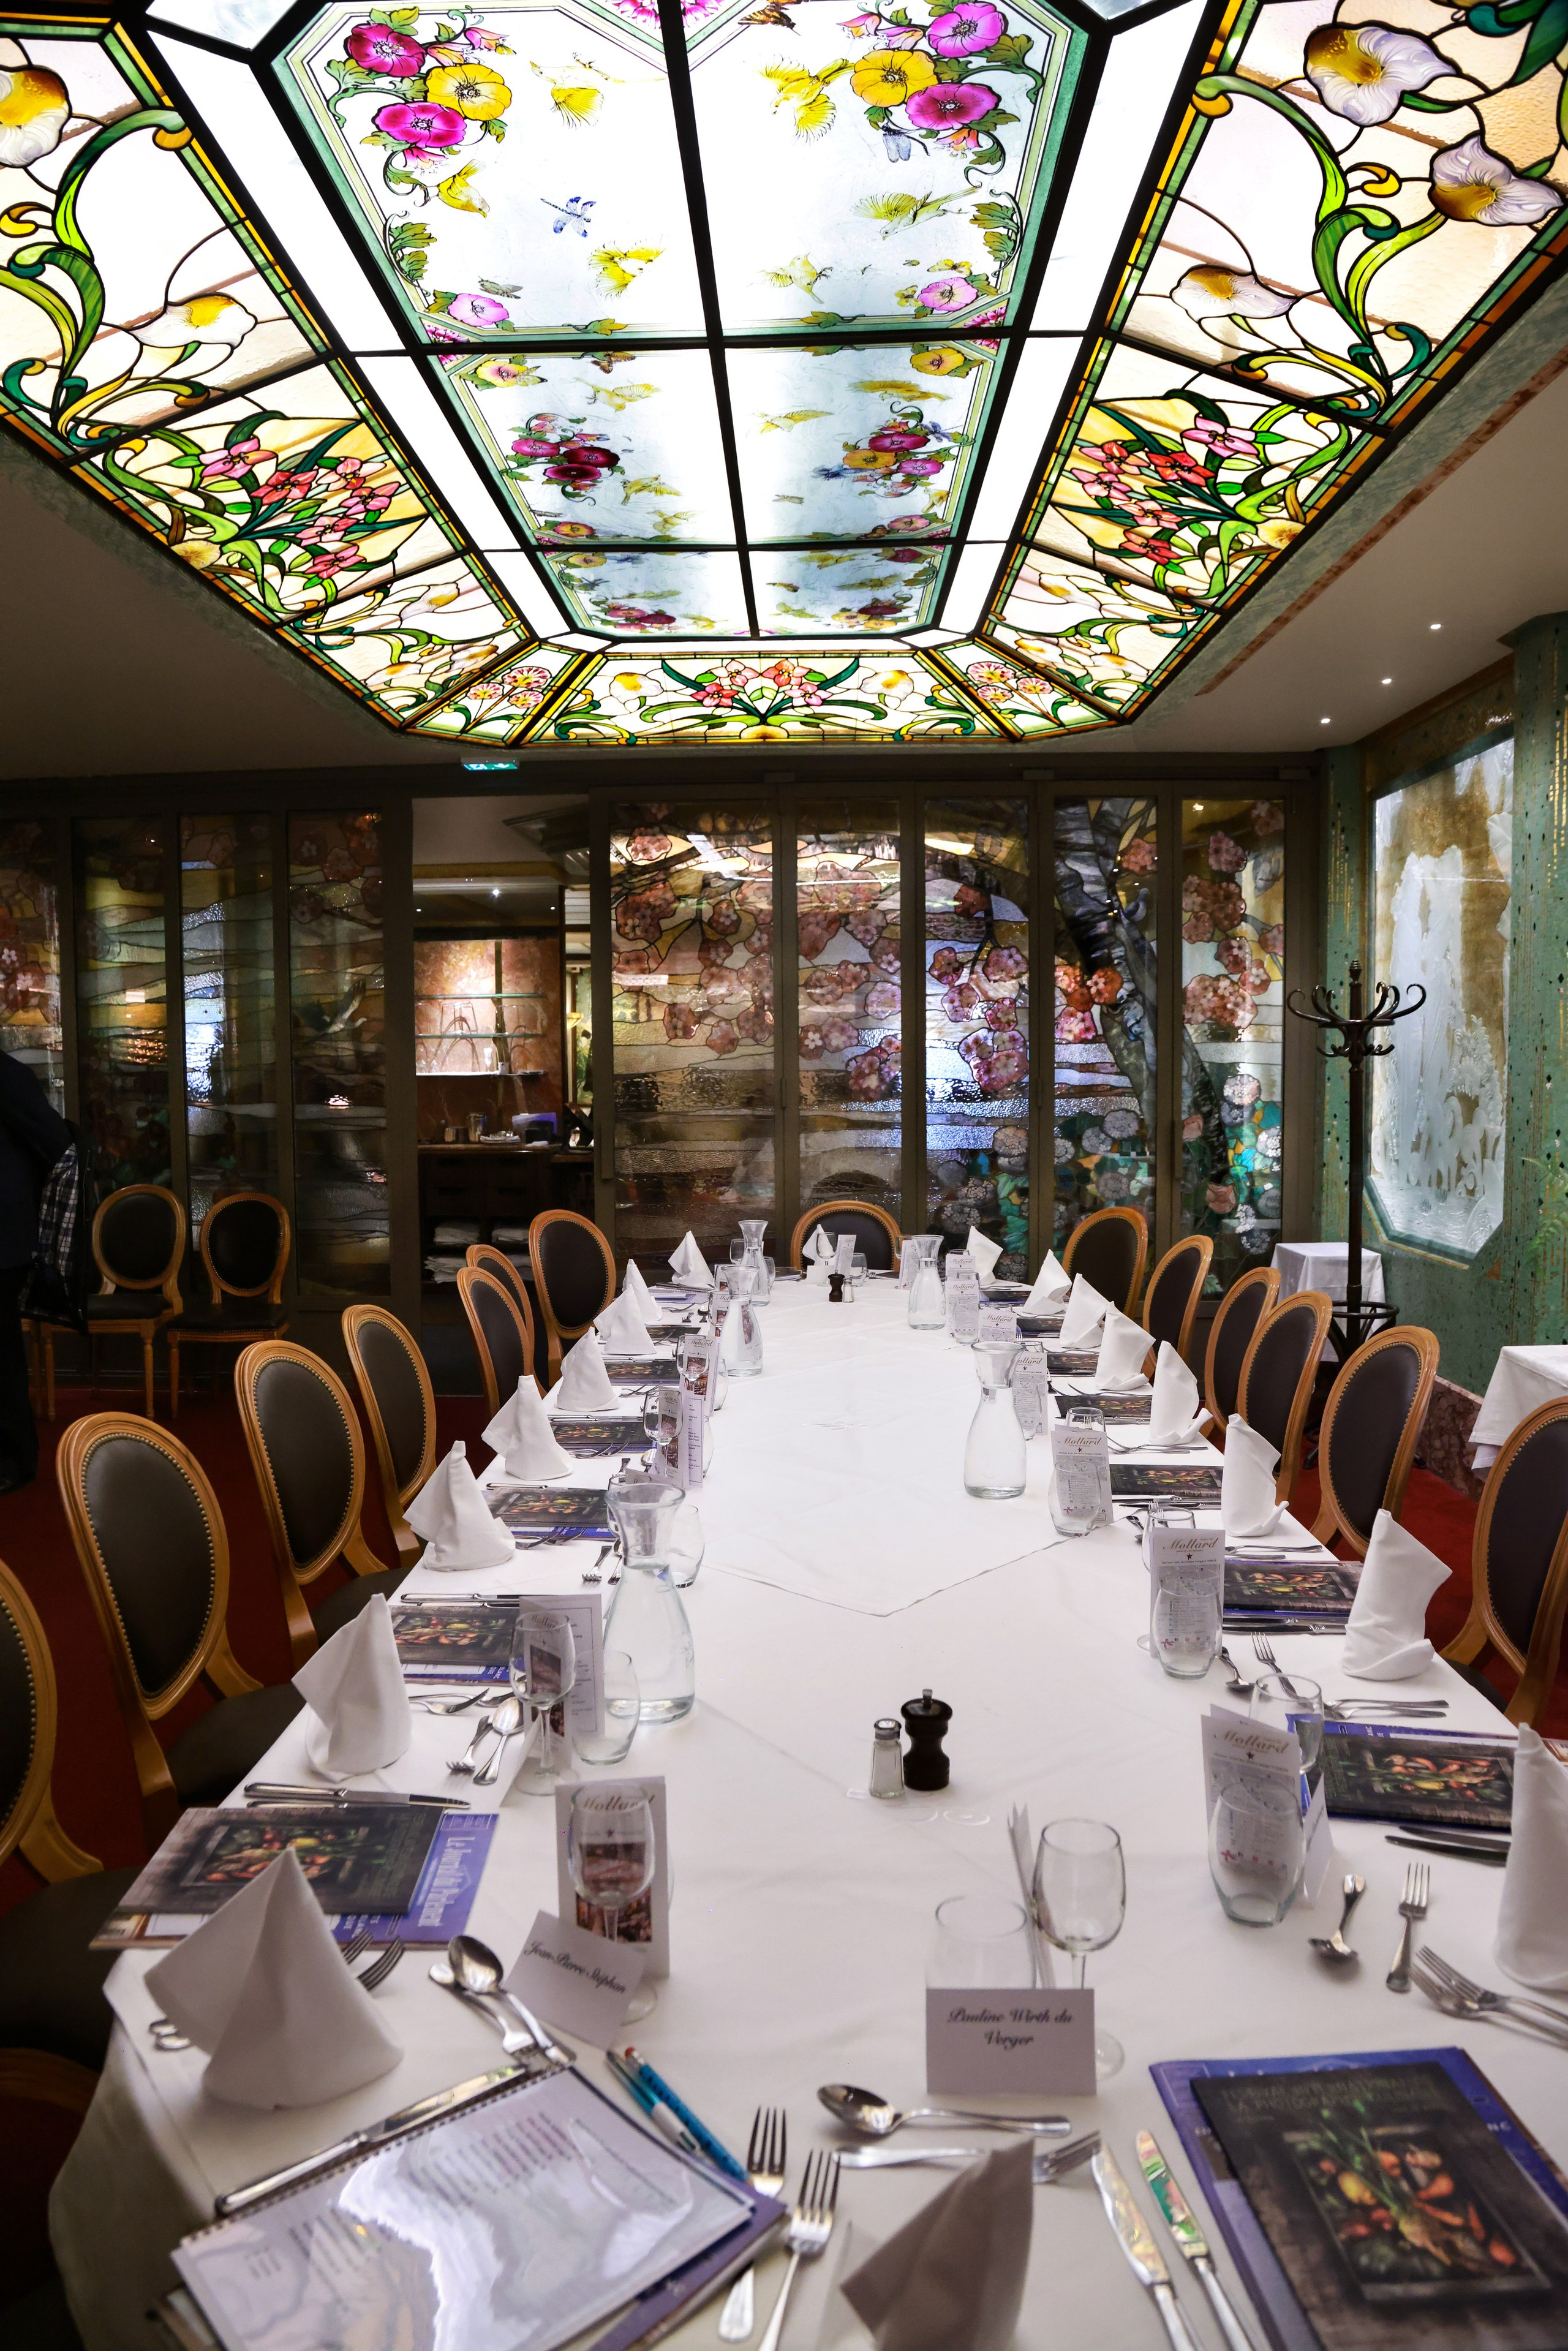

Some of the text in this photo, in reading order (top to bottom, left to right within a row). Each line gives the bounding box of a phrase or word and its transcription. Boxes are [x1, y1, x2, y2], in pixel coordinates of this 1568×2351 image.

[1058, 1436, 1102, 1446] Mollard
[1163, 1538, 1218, 1550] Mollard
[1214, 1730, 1289, 1754] Mollard
[948, 2007, 1005, 2023] Pauline
